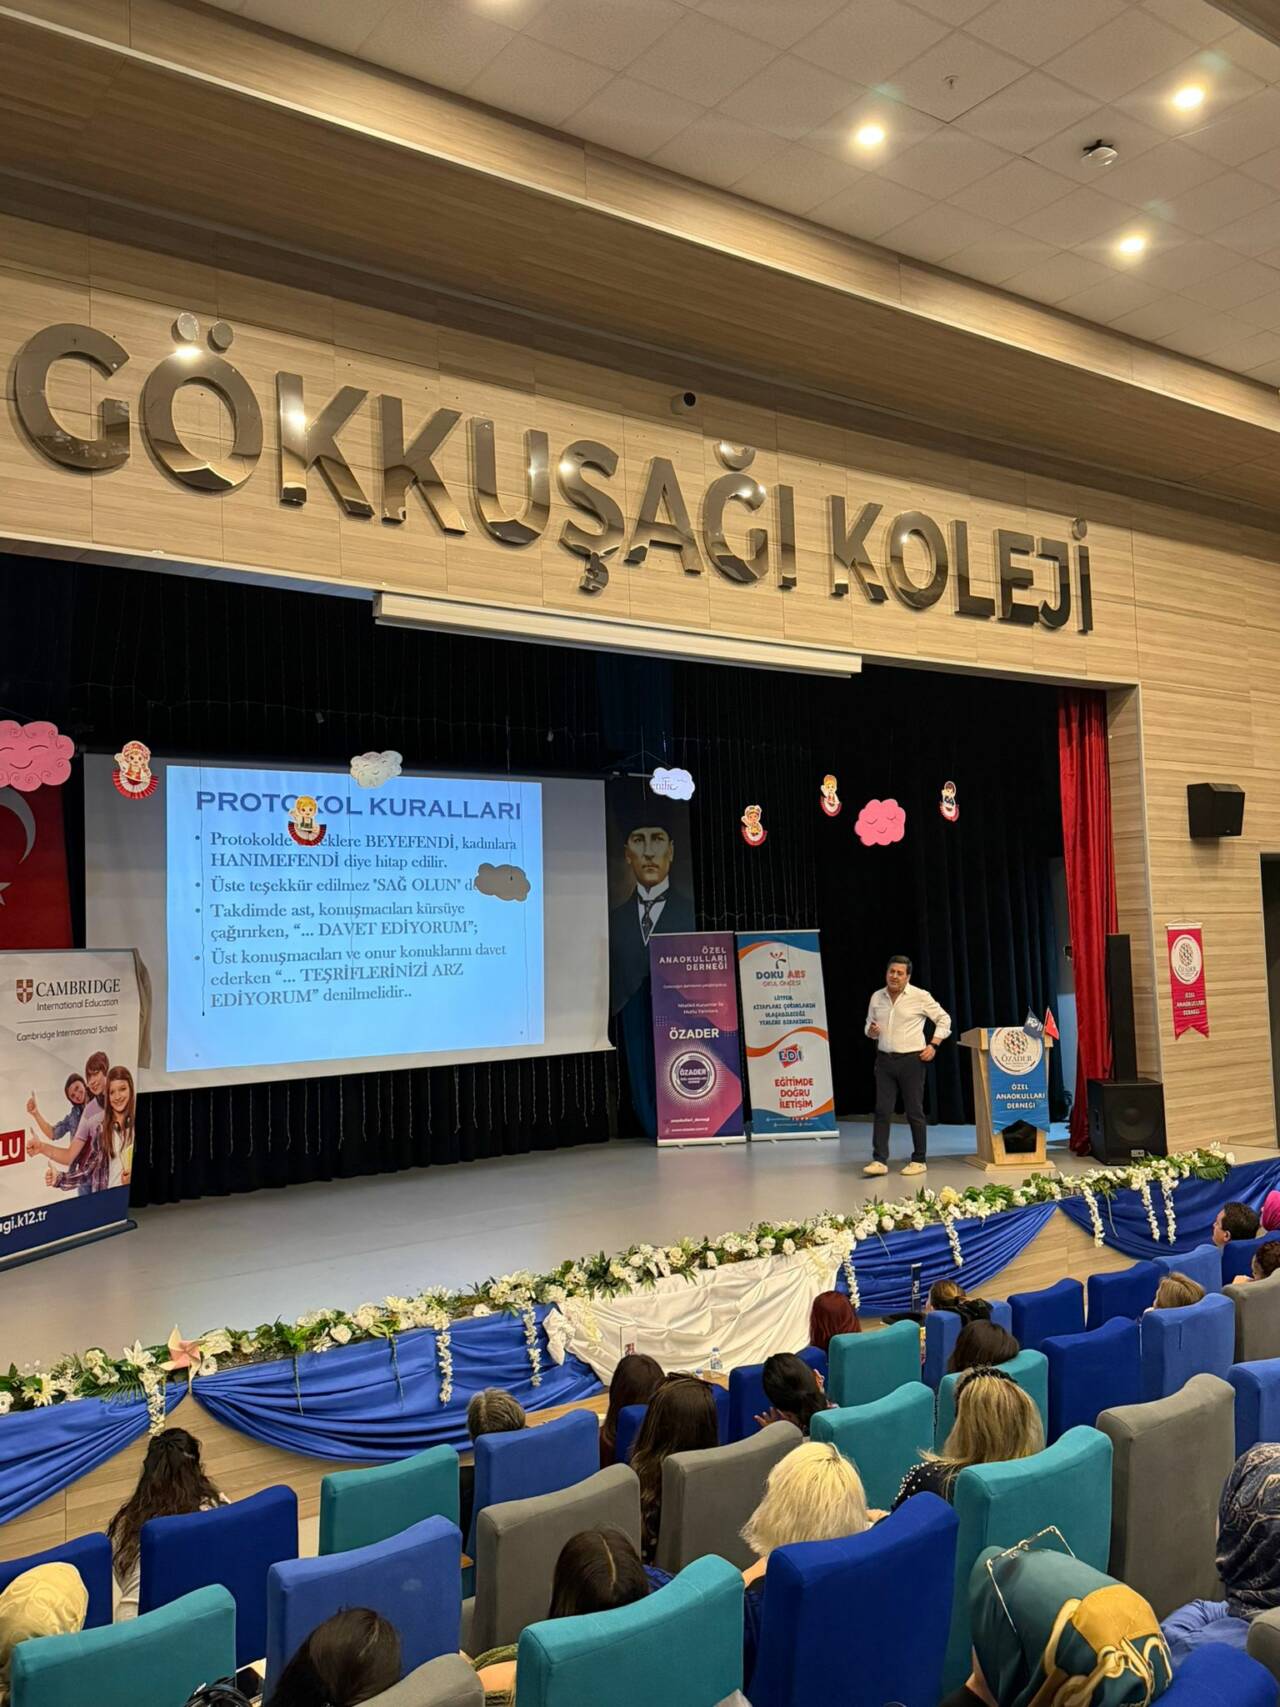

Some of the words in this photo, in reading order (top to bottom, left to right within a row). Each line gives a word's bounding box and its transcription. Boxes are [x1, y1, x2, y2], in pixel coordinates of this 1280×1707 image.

[14, 313, 797, 592] GÖKKUŞAĞI
[827, 495, 1094, 635] KOLEJİ
[370, 797, 521, 820] KURALLARI
[210, 831, 292, 847] Protokolde
[365, 833, 459, 850] BEYEFENDİ,
[462, 836, 517, 850] kadınlara
[210, 851, 340, 867] HANIMEFENDİ
[344, 854, 372, 870] diye
[375, 854, 408, 870] hitap
[411, 855, 448, 868] edilir.
[211, 875, 245, 893] Üste
[249, 878, 312, 895] teşekkür
[316, 878, 370, 892] edilmez
[210, 903, 287, 918] Takdimde
[291, 906, 315, 918] ast,
[319, 902, 413, 919] konuşmacıları
[416, 901, 465, 917] kürsüye
[210, 924, 289, 942] çağırırken,
[318, 921, 378, 937] DAVET
[211, 948, 238, 965] Üst
[241, 947, 342, 966] konuşmacıları
[346, 950, 361, 961] ve
[364, 949, 397, 960] onur
[400, 945, 472, 958] konuklarını
[475, 943, 507, 956] davet
[701, 945, 727, 954] ÖZEL
[210, 970, 271, 986] ederken
[300, 962, 428, 984] TEŞRİFLERİNİZİ
[431, 963, 464, 977] ARZ
[756, 971, 784, 980] DOKU
[36, 979, 120, 997] CAMBRIDGE
[37, 1000, 83, 1012] International
[85, 998, 119, 1008] Education
[16, 1031, 55, 1042] Cambridge
[56, 1026, 97, 1038] International
[98, 1024, 118, 1034] School
[669, 1027, 720, 1039] ÖZADER
[774, 1075, 814, 1087] EĞİTİMDE
[780, 1086, 810, 1098] DOĞRU
